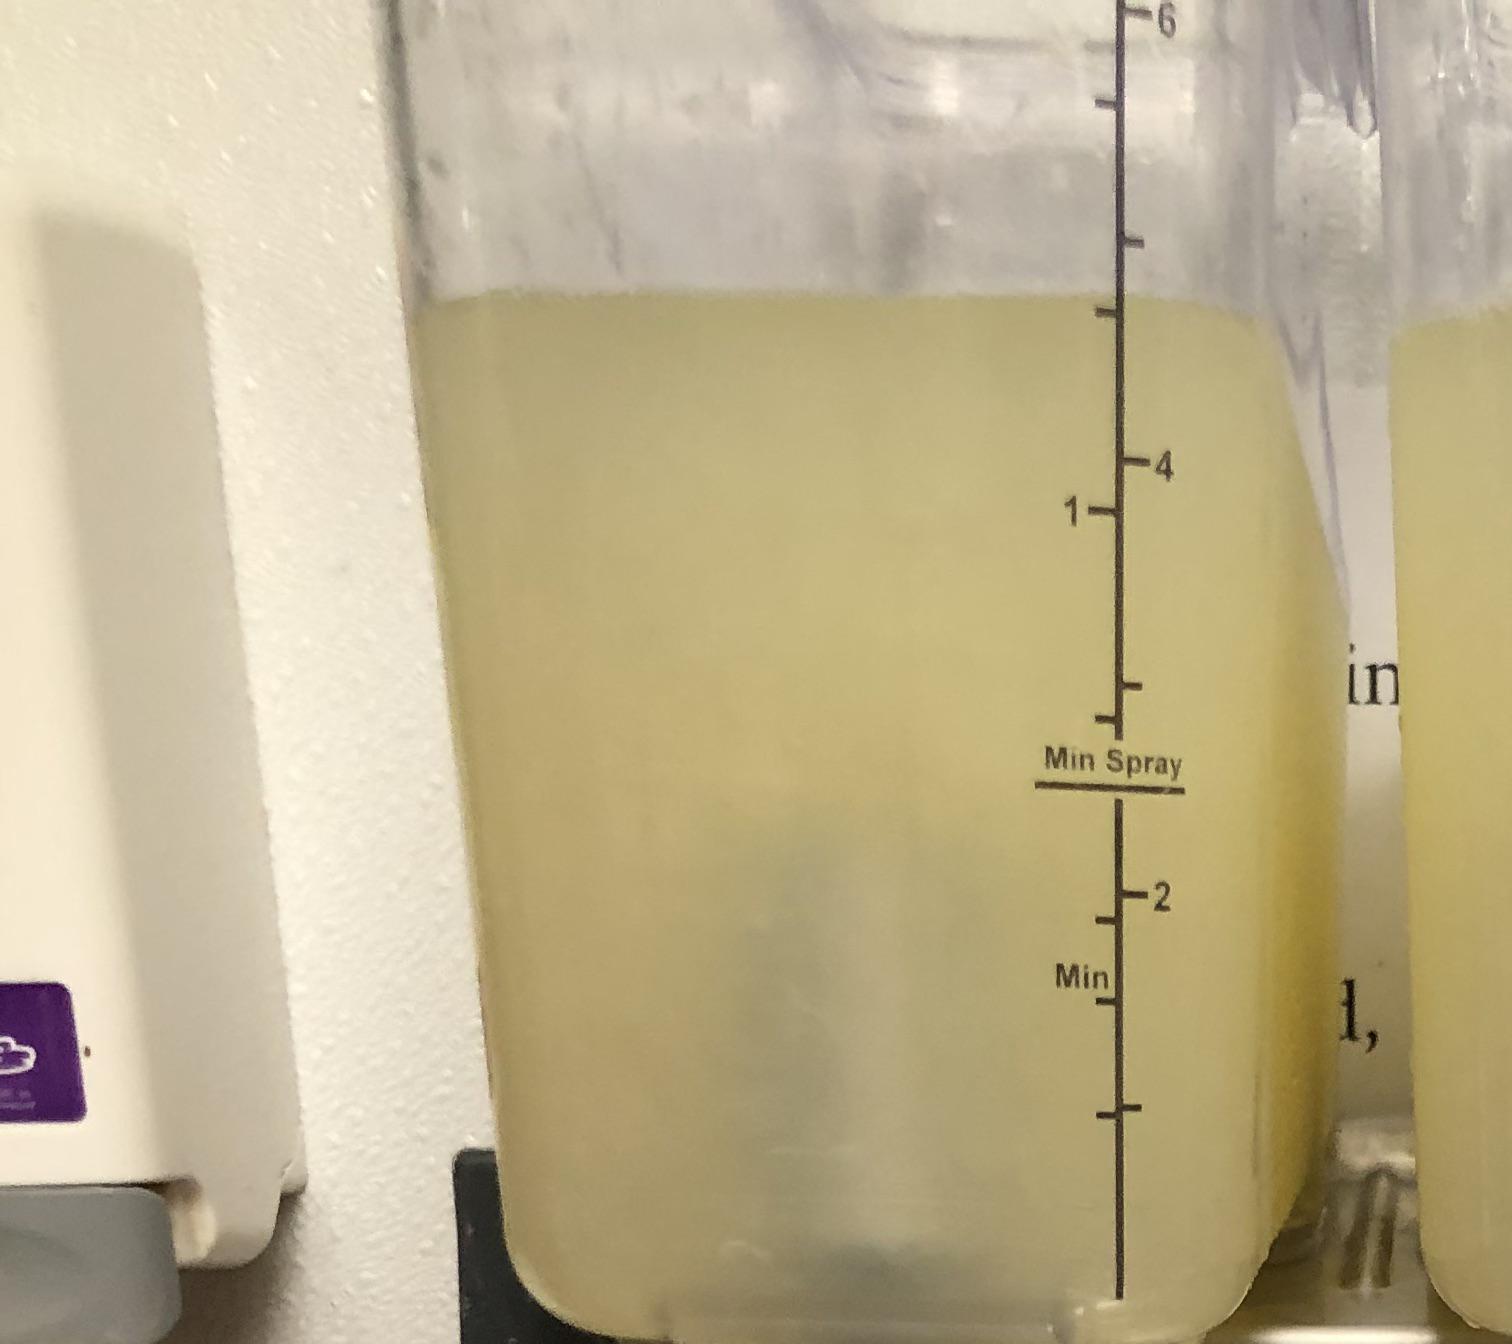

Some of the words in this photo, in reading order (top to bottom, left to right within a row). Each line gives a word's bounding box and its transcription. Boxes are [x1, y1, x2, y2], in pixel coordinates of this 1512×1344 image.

[1158, 2, 1177, 38] 6
[1155, 450, 1174, 482] 4
[1065, 495, 1078, 527] 1
[1044, 746, 1096, 773] Min
[1106, 749, 1183, 781] Spray
[1154, 881, 1171, 912] 2
[1055, 963, 1109, 990] Min
